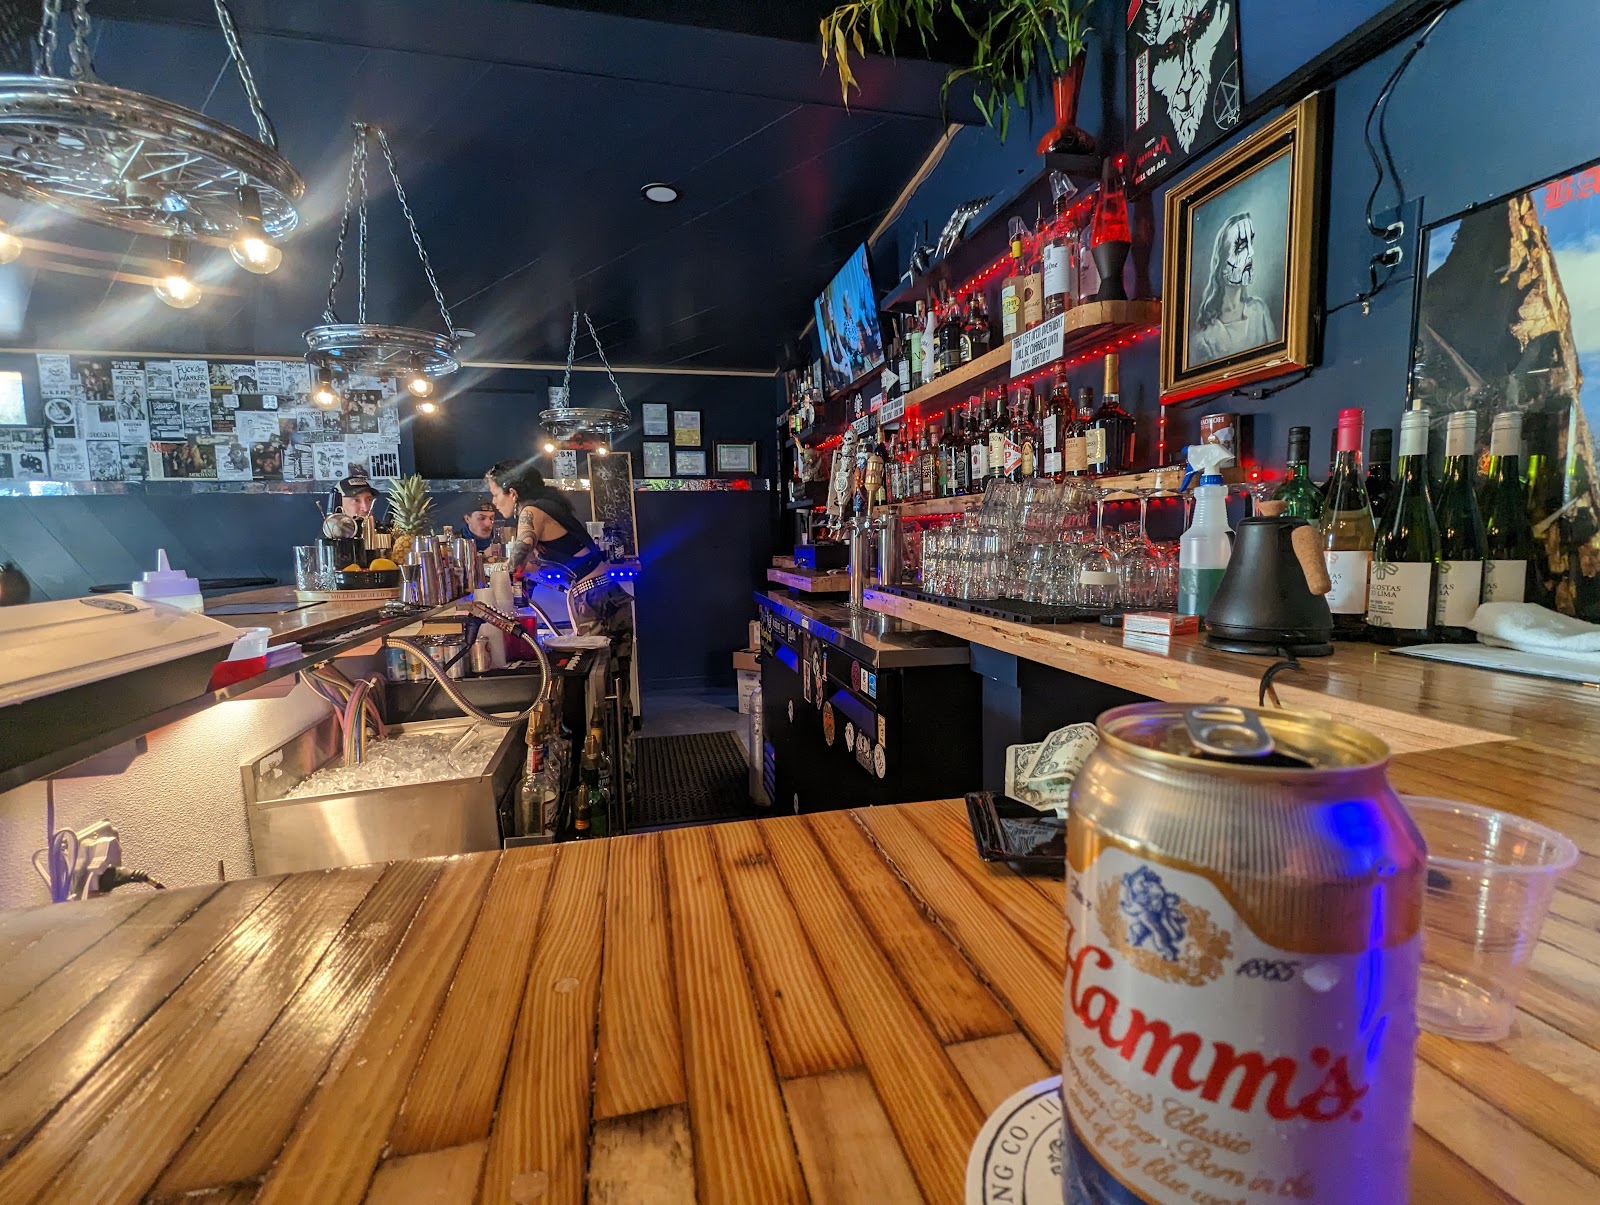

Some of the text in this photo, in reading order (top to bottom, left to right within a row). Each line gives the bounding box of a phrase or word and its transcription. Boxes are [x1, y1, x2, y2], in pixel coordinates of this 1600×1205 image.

[1157, 158, 1167, 170] ALL
[1023, 332, 1031, 345] LEFT
[1032, 328, 1041, 341] OPEN
[1042, 316, 1063, 336] OVERNIGHT
[1015, 333, 1059, 361] WILL BE CHARGED WITH
[1032, 349, 1050, 366] GRATUITY
[176, 365, 195, 374] FUCK
[178, 374, 208, 382] WANKERS
[1076, 1044, 1252, 1154] America's Classic
[1142, 1156, 1190, 1194] blue
[1177, 1138, 1246, 1187] Born
